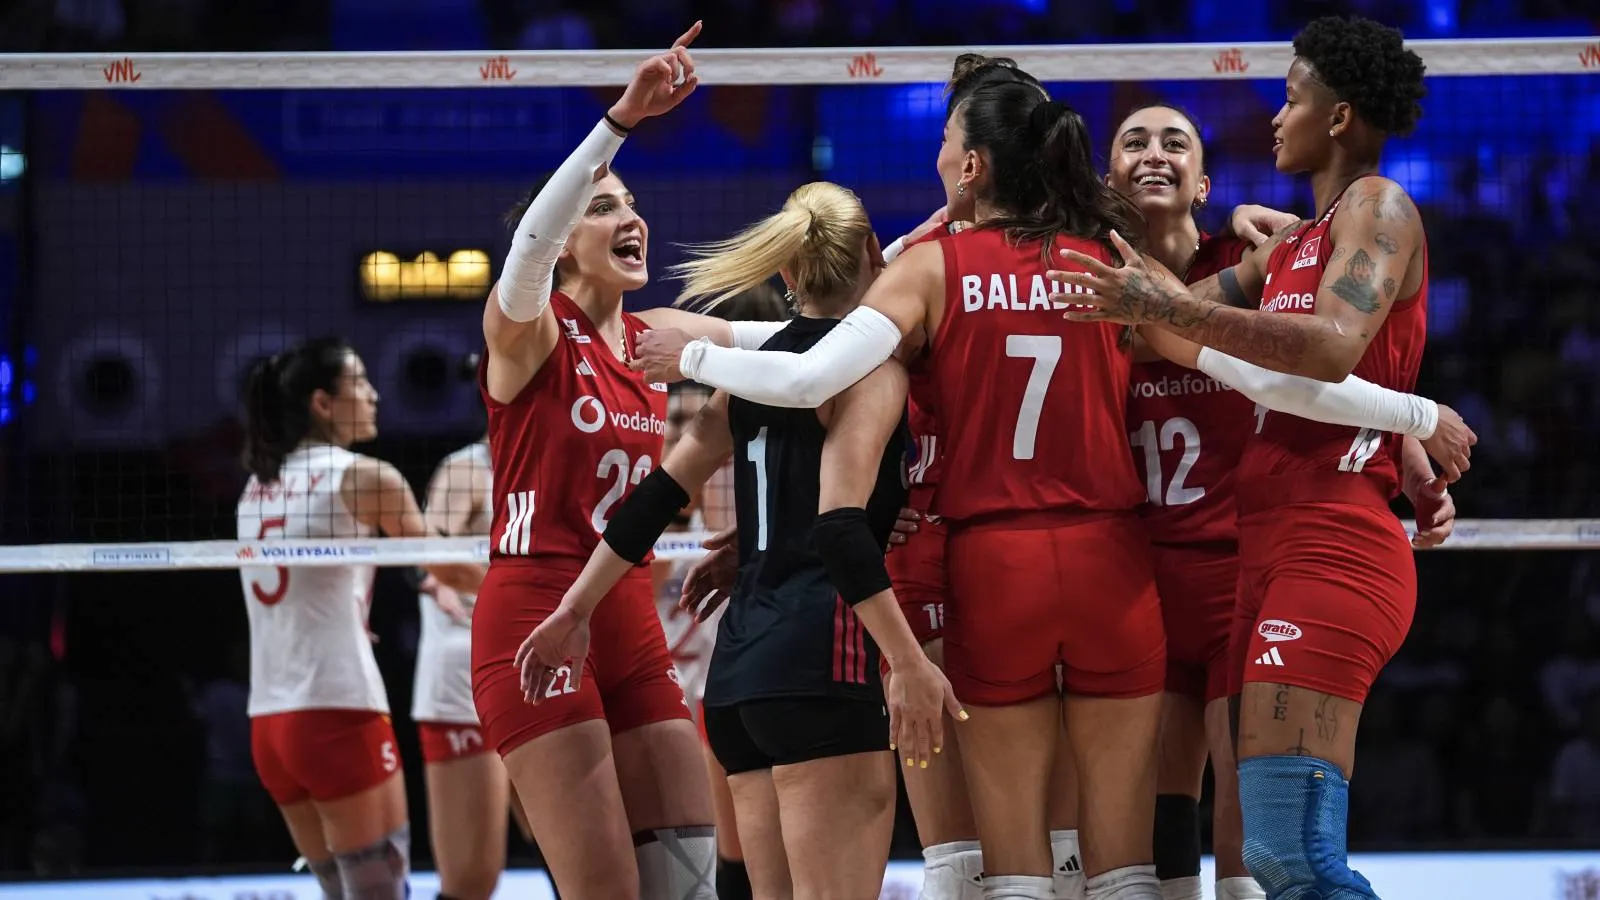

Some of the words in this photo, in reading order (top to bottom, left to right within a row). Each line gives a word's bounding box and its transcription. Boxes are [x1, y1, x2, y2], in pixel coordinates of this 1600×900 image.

[480, 55, 517, 80] VNL
[847, 51, 885, 79] VNL
[1212, 48, 1249, 73] VNL
[1578, 42, 1600, 68] VN
[103, 57, 141, 83] VNL
[962, 273, 1095, 312] BALAD
[1006, 335, 1062, 460] 7
[609, 411, 666, 436] vodafon
[1131, 417, 1206, 506] 12
[748, 426, 768, 551] 1
[261, 546, 345, 557] VOLLEYBALL
[1260, 624, 1297, 636] gratis
[545, 665, 577, 698] 22
[382, 741, 397, 772] 5
